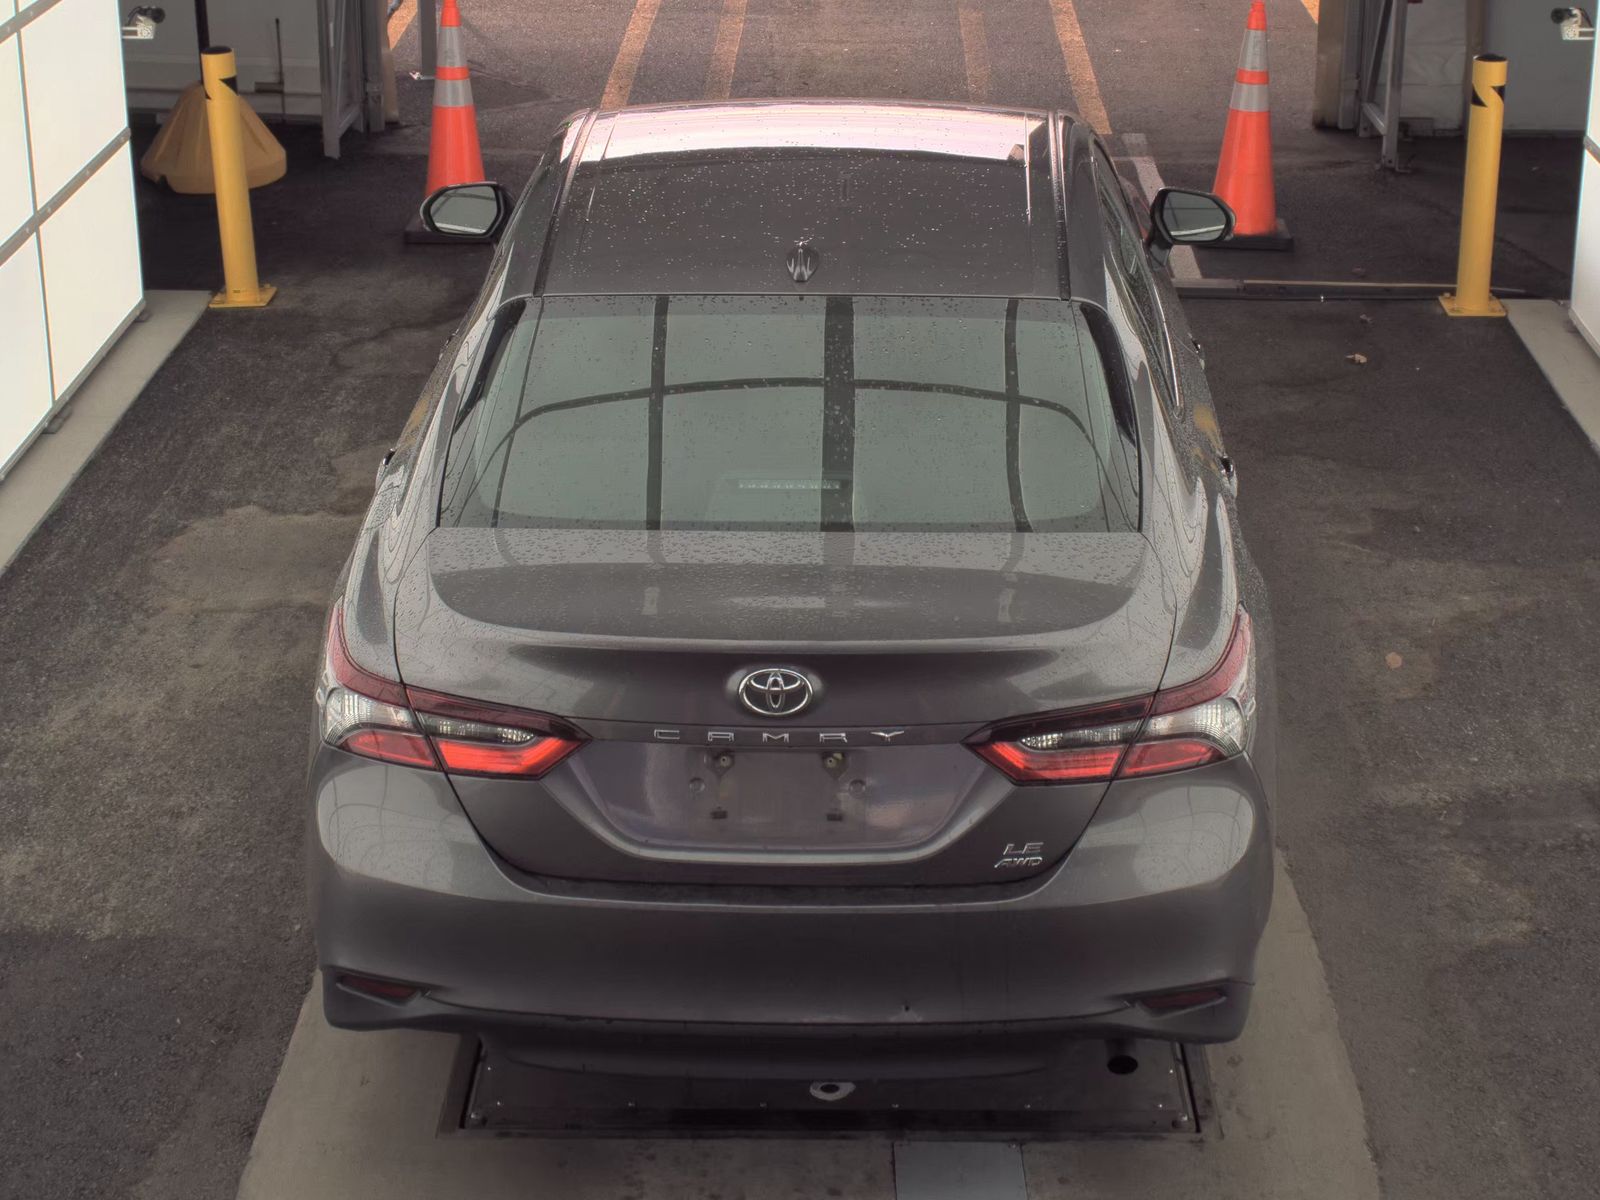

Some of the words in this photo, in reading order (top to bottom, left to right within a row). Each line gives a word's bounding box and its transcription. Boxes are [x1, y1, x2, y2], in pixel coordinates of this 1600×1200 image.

[653, 729, 905, 743] CAMRY
[1002, 842, 1044, 855] LE
[994, 857, 1043, 868] AWD
